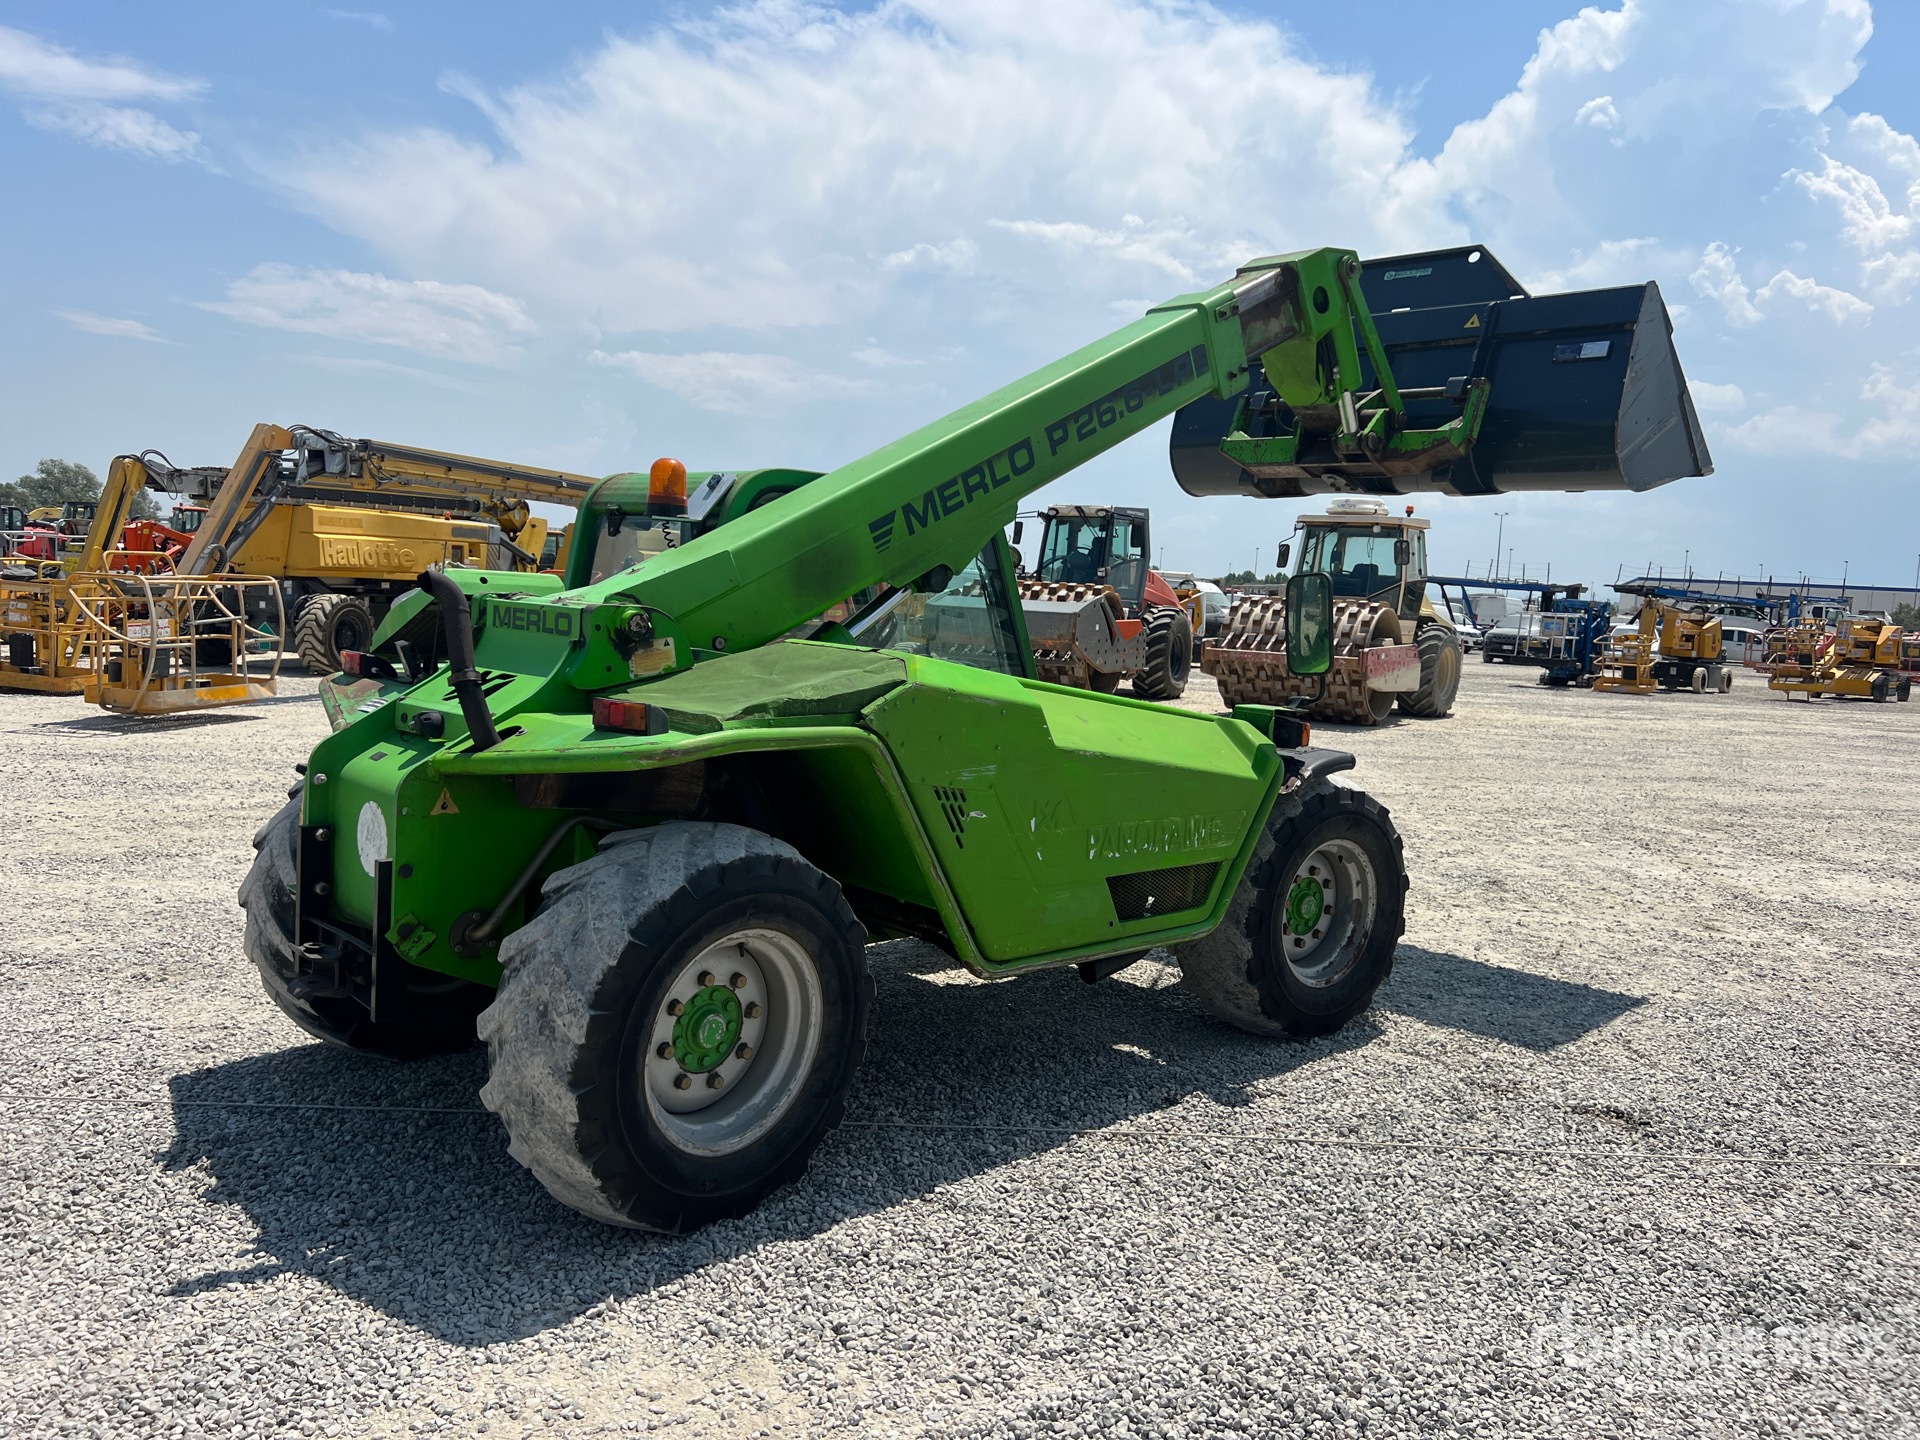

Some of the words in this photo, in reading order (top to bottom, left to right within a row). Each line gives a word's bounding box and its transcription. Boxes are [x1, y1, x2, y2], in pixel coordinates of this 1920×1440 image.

[902, 436, 1035, 536] MERLO
[320, 538, 416, 567] Haulotte
[492, 604, 572, 636] MERLO
